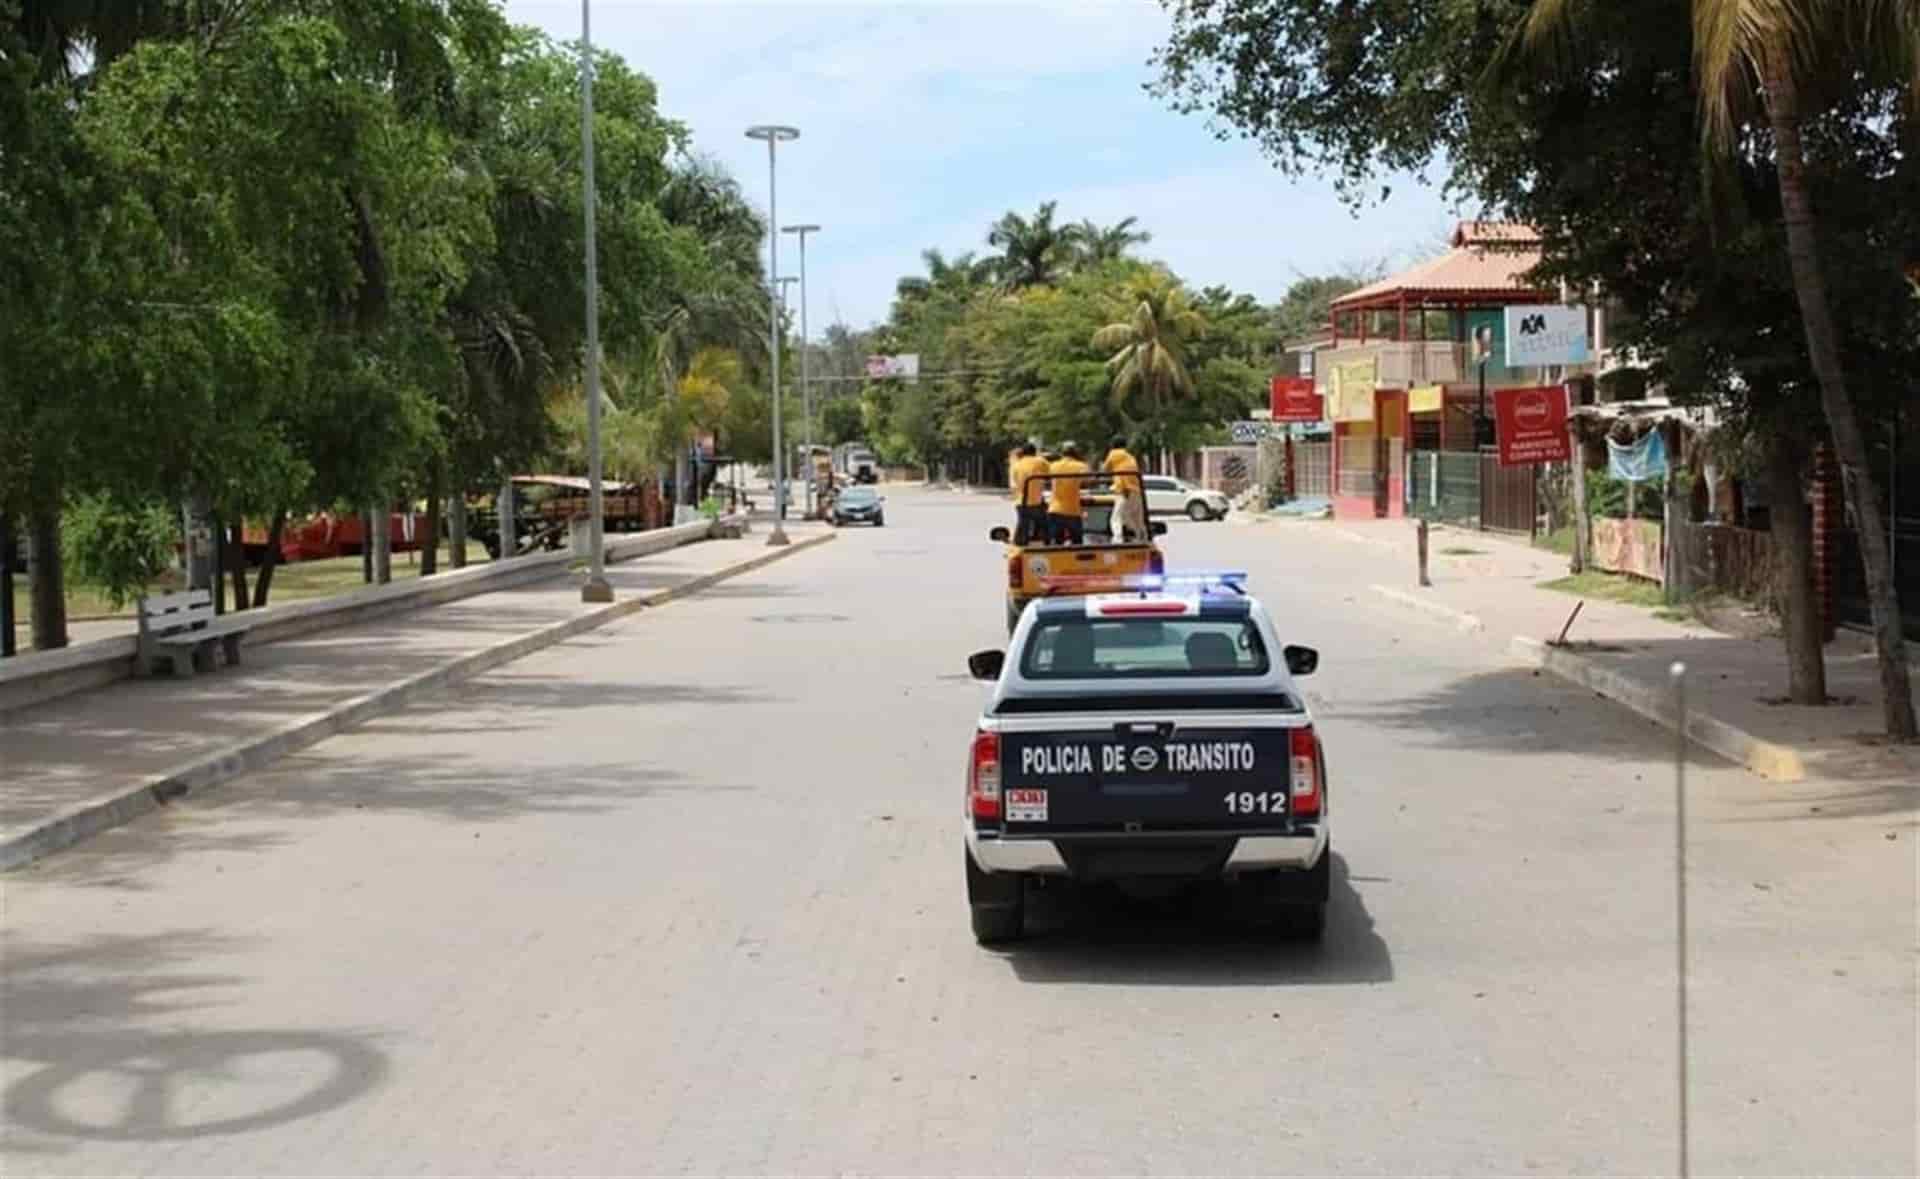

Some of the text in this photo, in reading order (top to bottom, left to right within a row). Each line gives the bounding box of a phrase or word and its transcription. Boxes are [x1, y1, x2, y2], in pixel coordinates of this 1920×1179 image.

[1022, 742, 1255, 774] POLICIA DE TRANSITO
[1224, 791, 1286, 813] 1912
